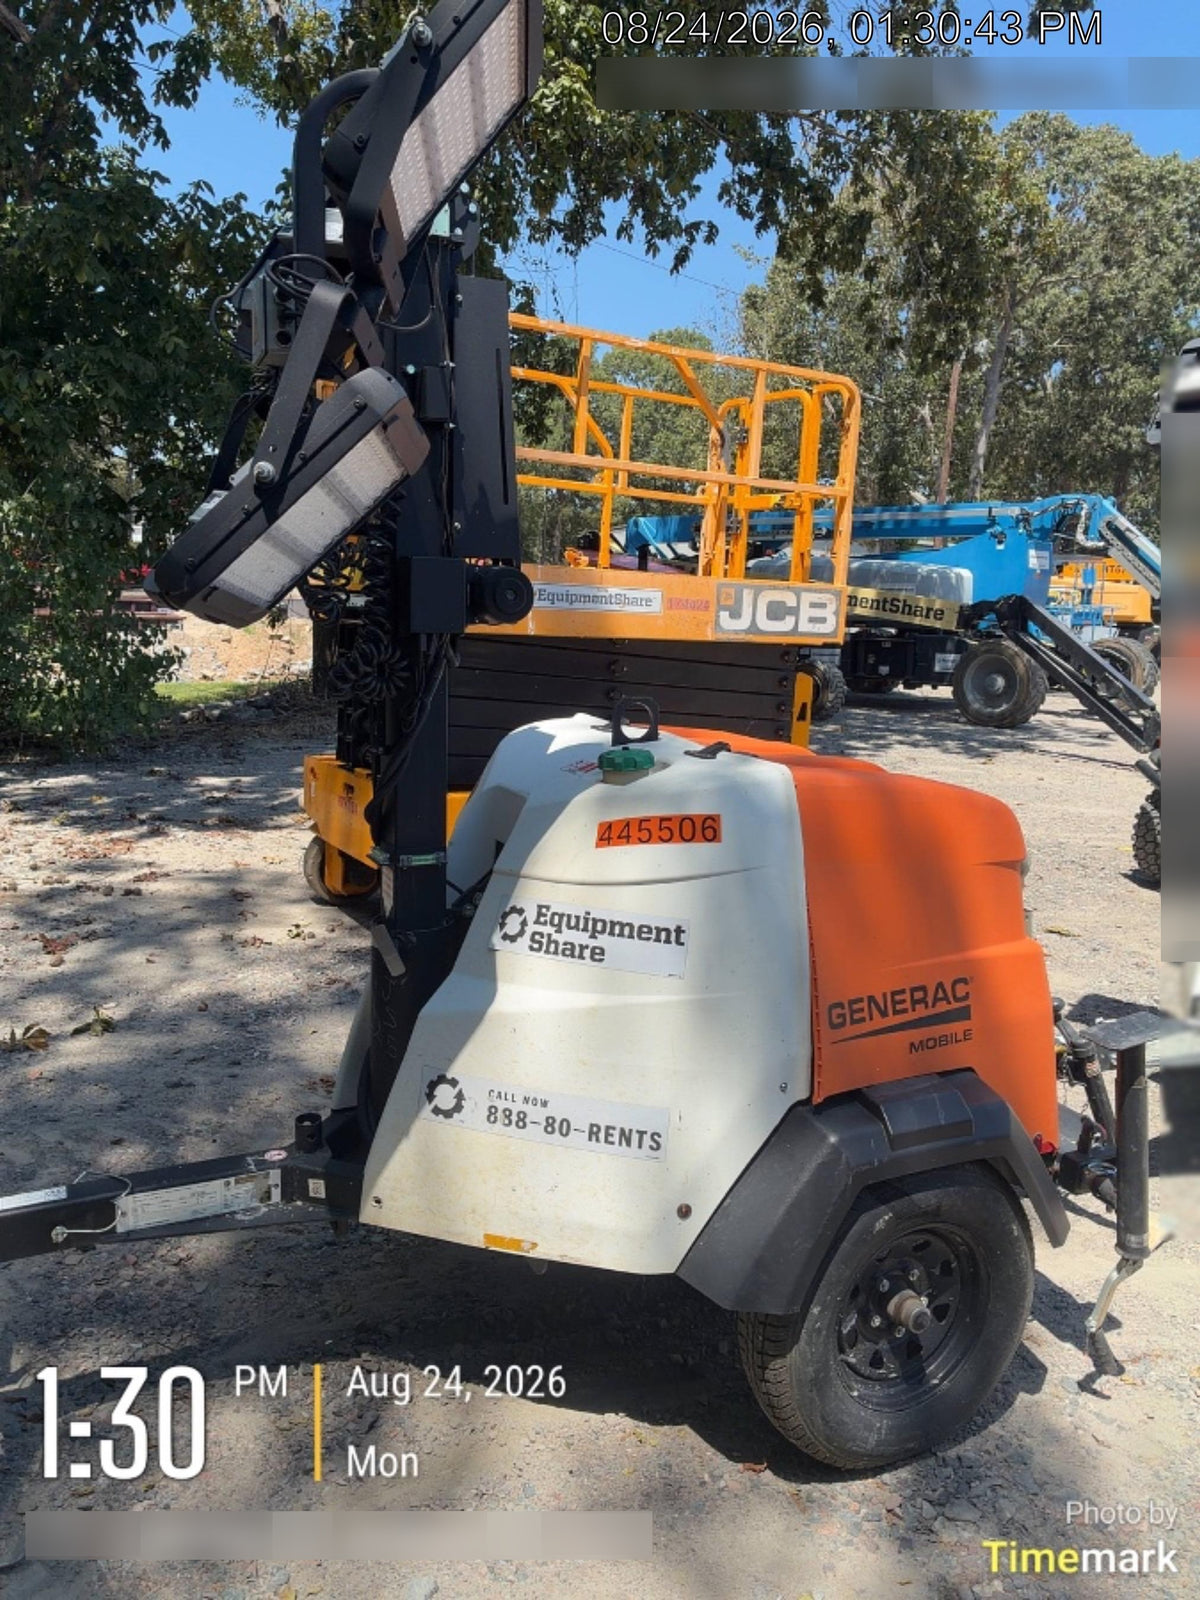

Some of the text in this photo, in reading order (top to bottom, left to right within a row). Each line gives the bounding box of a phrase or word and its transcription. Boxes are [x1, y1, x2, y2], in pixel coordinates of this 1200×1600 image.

[537, 588, 653, 607] EquipmentShare
[719, 590, 837, 634] JCB
[599, 815, 719, 846] 445506
[533, 903, 687, 947] Equipment
[528, 930, 606, 964] Share
[827, 976, 971, 1030] GENERAC
[909, 1028, 973, 1055] MOBILE
[488, 1088, 549, 1109] CALL NOW
